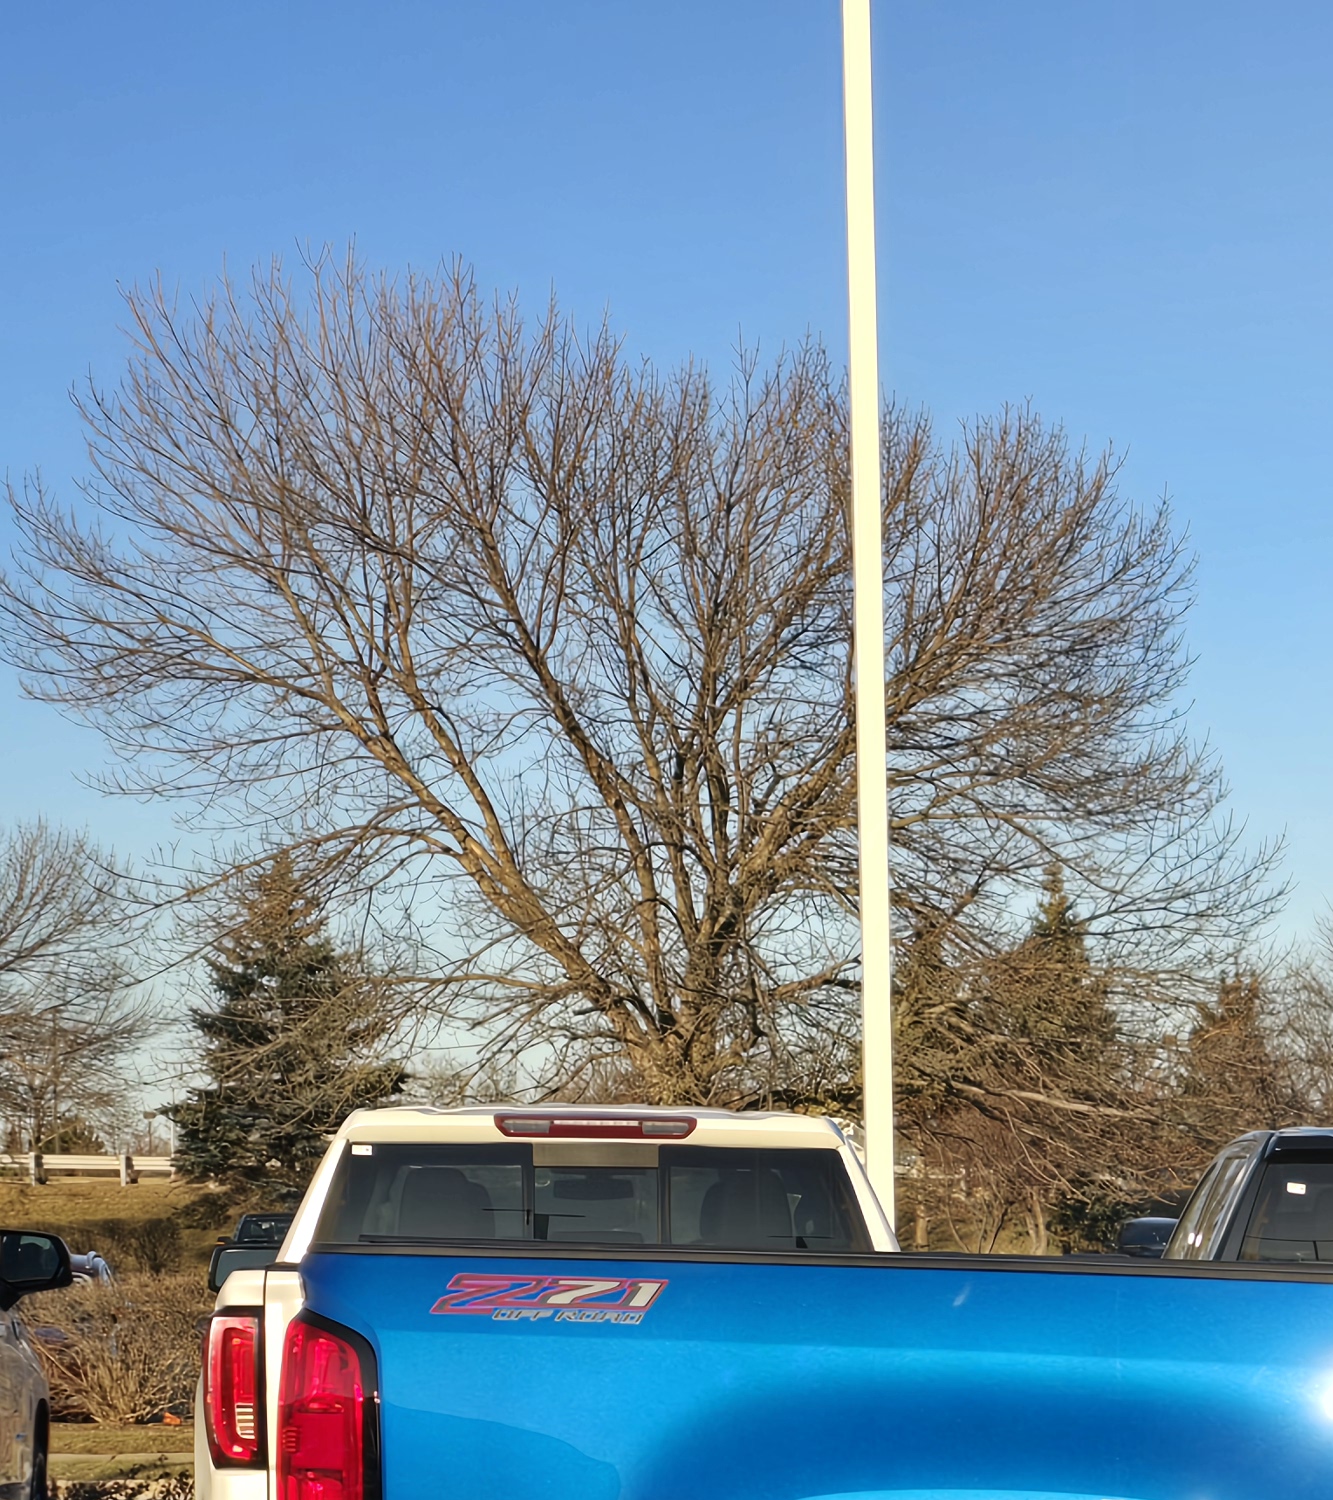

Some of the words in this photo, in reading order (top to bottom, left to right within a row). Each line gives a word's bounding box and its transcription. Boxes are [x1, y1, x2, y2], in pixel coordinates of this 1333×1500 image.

[430, 1273, 669, 1314] Z71
[492, 1308, 553, 1322] OFF
[554, 1311, 642, 1325] ROAD
